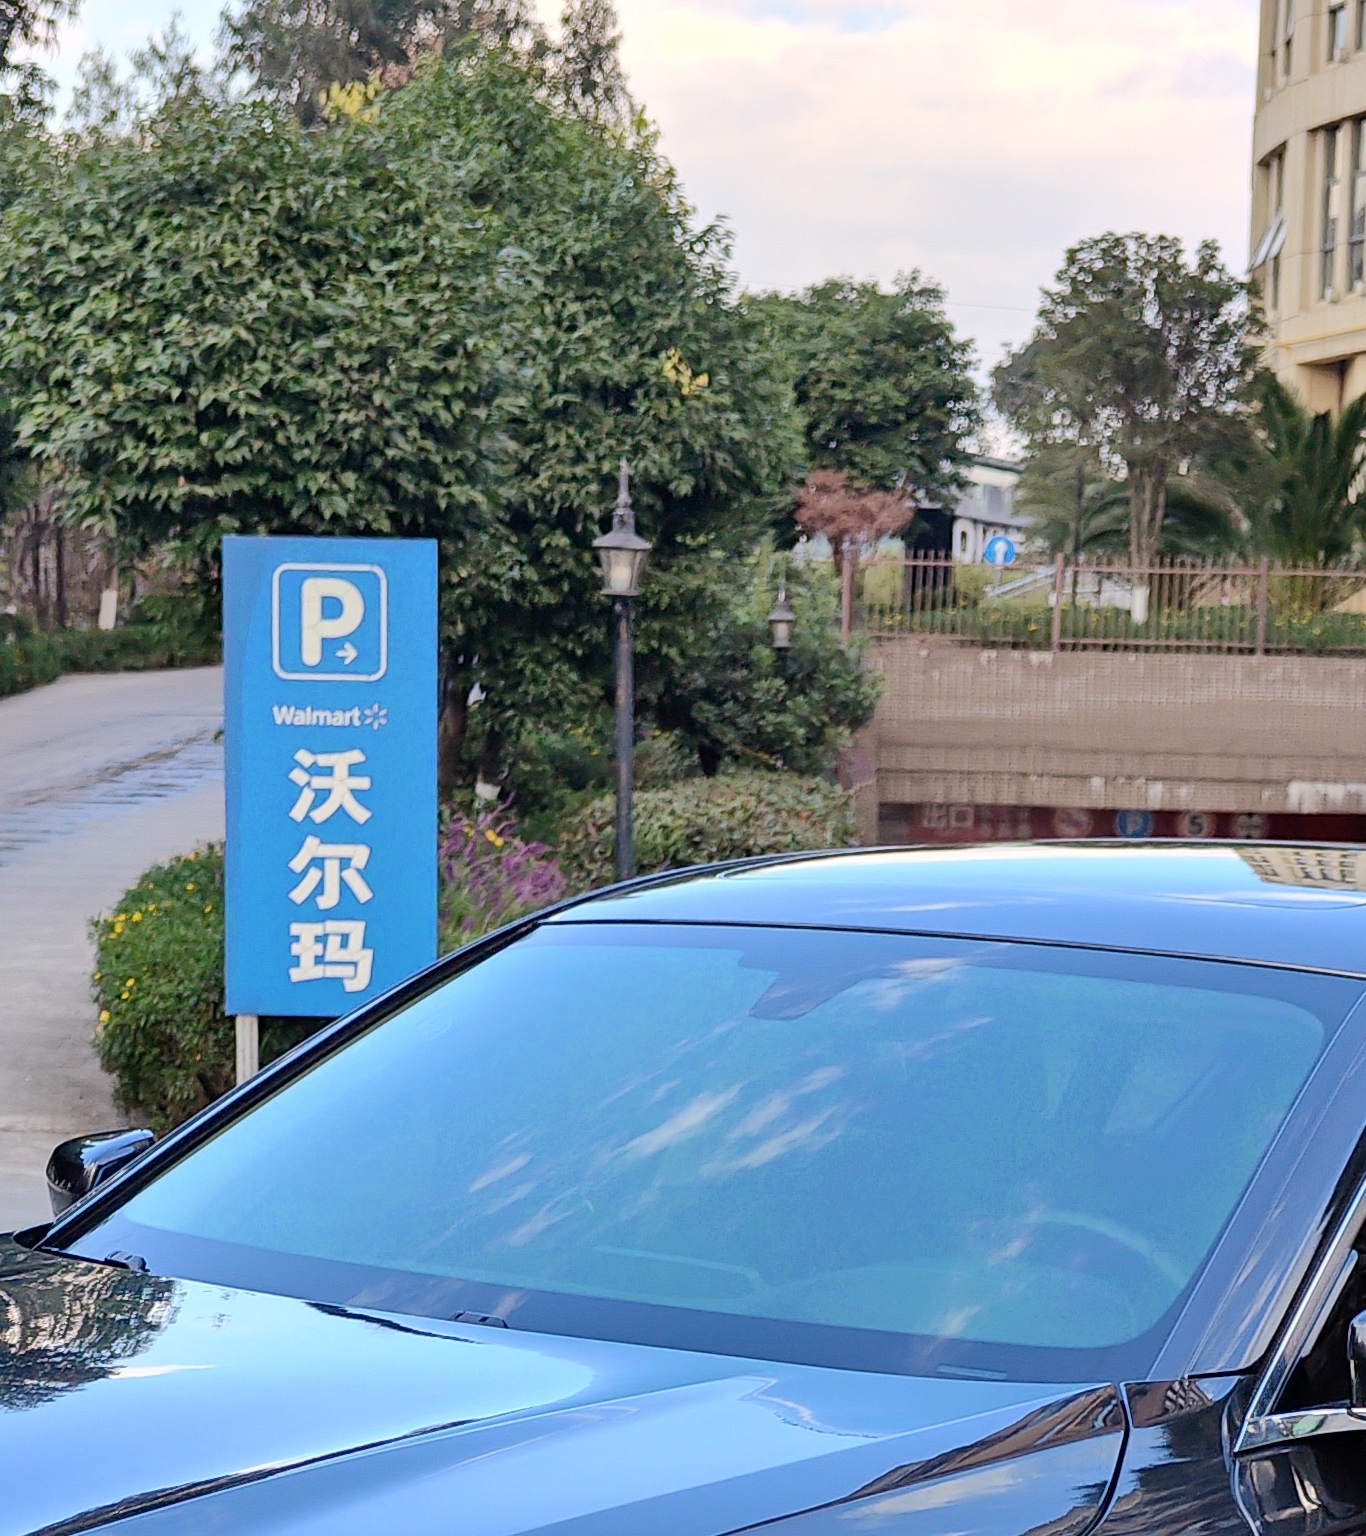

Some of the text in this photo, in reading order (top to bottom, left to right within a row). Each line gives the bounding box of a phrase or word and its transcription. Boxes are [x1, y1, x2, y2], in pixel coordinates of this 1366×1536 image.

[302, 577, 365, 667] P
[272, 704, 361, 727] Walmart
[288, 748, 373, 993] 沃尔玛
